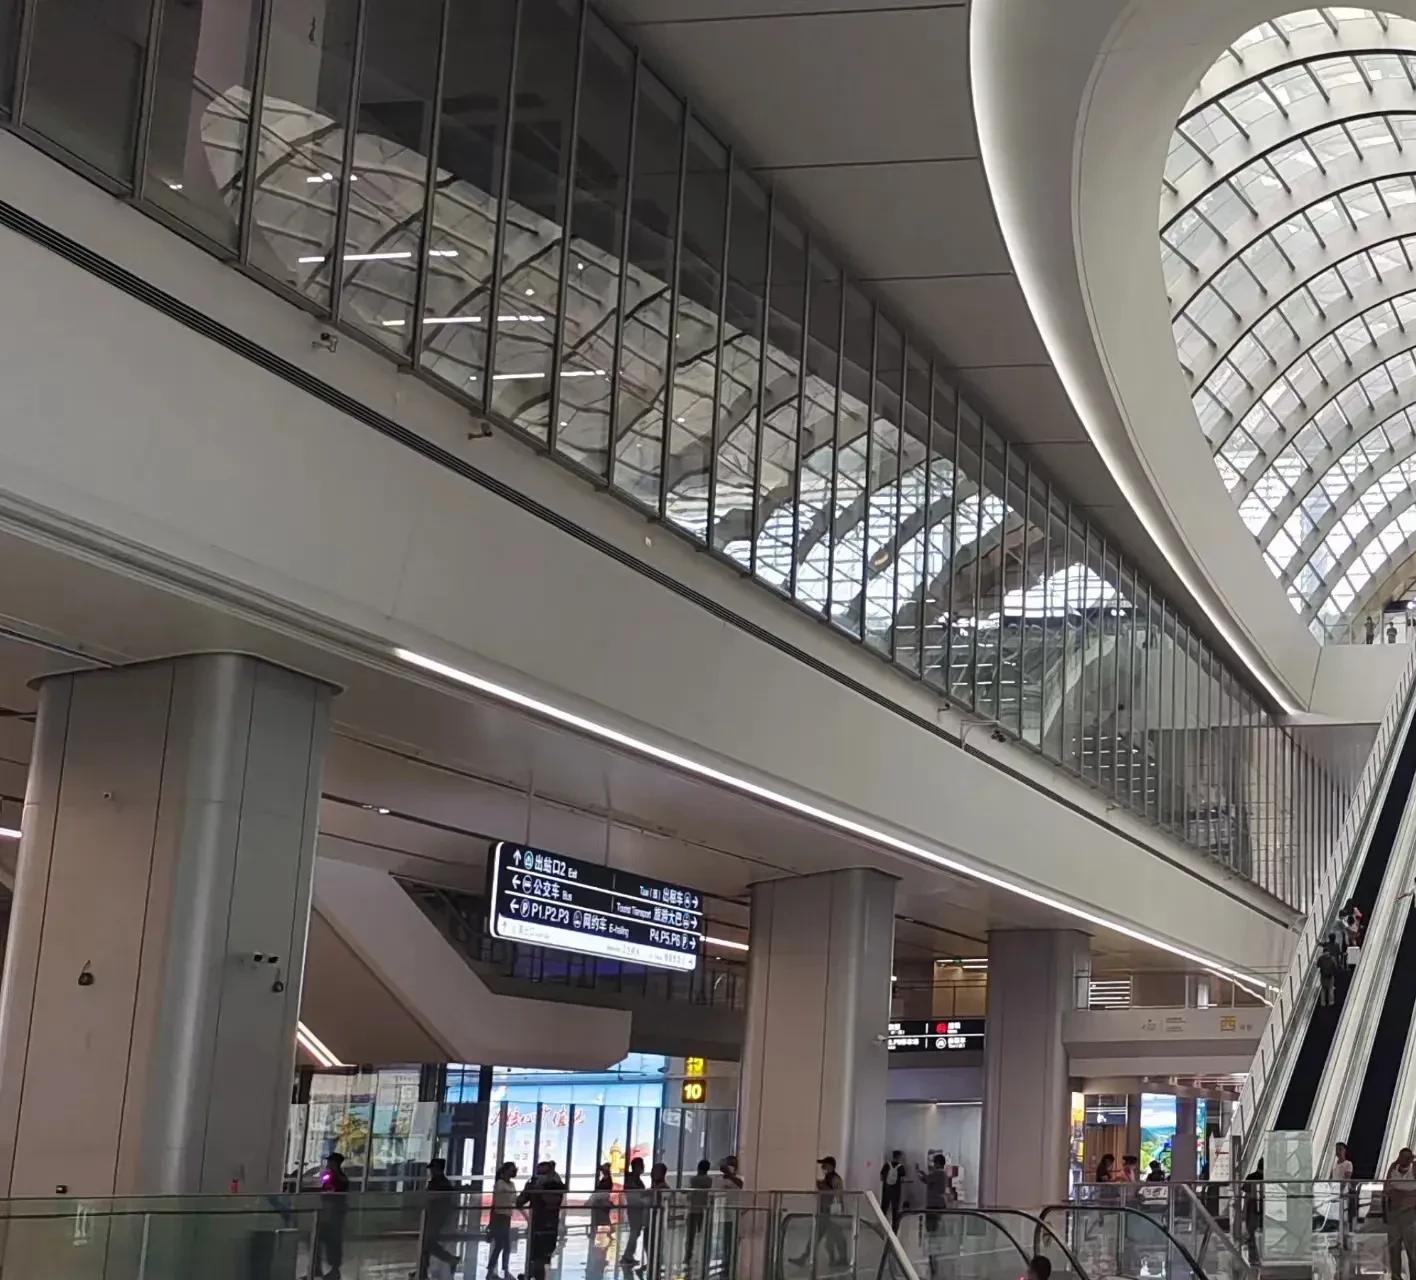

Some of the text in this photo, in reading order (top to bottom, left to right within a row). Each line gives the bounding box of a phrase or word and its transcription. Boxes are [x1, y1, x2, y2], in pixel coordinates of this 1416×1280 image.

[534, 854, 567, 877] 出站口2
[533, 878, 561, 898] 公交车
[662, 887, 684, 906] 出租车
[583, 912, 607, 931] 网约车
[653, 906, 683, 926] 旅游大巴
[684, 1083, 702, 1100] 10
